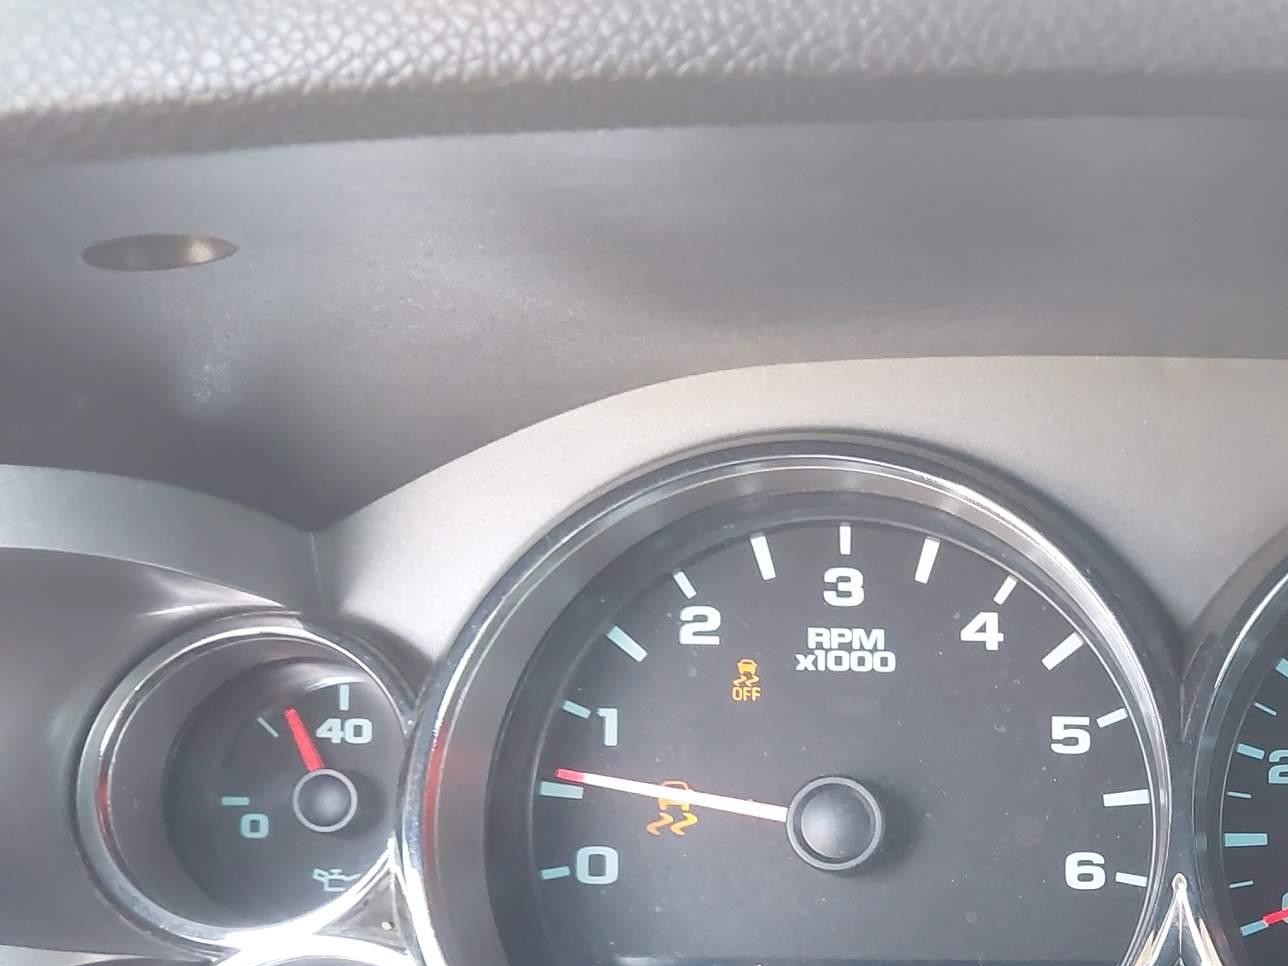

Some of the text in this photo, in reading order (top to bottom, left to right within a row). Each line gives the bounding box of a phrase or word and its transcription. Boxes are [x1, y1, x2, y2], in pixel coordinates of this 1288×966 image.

[823, 567, 865, 607] 3
[678, 605, 722, 646] 2
[807, 627, 885, 650] RPM
[960, 611, 1004, 651] 4
[795, 649, 896, 673] x1000
[732, 686, 761, 701] OFF
[316, 718, 373, 744] 40
[597, 707, 618, 747] 1
[1050, 715, 1091, 755] 5
[240, 813, 270, 839] 0
[576, 845, 619, 885] 0
[1064, 852, 1106, 890] 6
